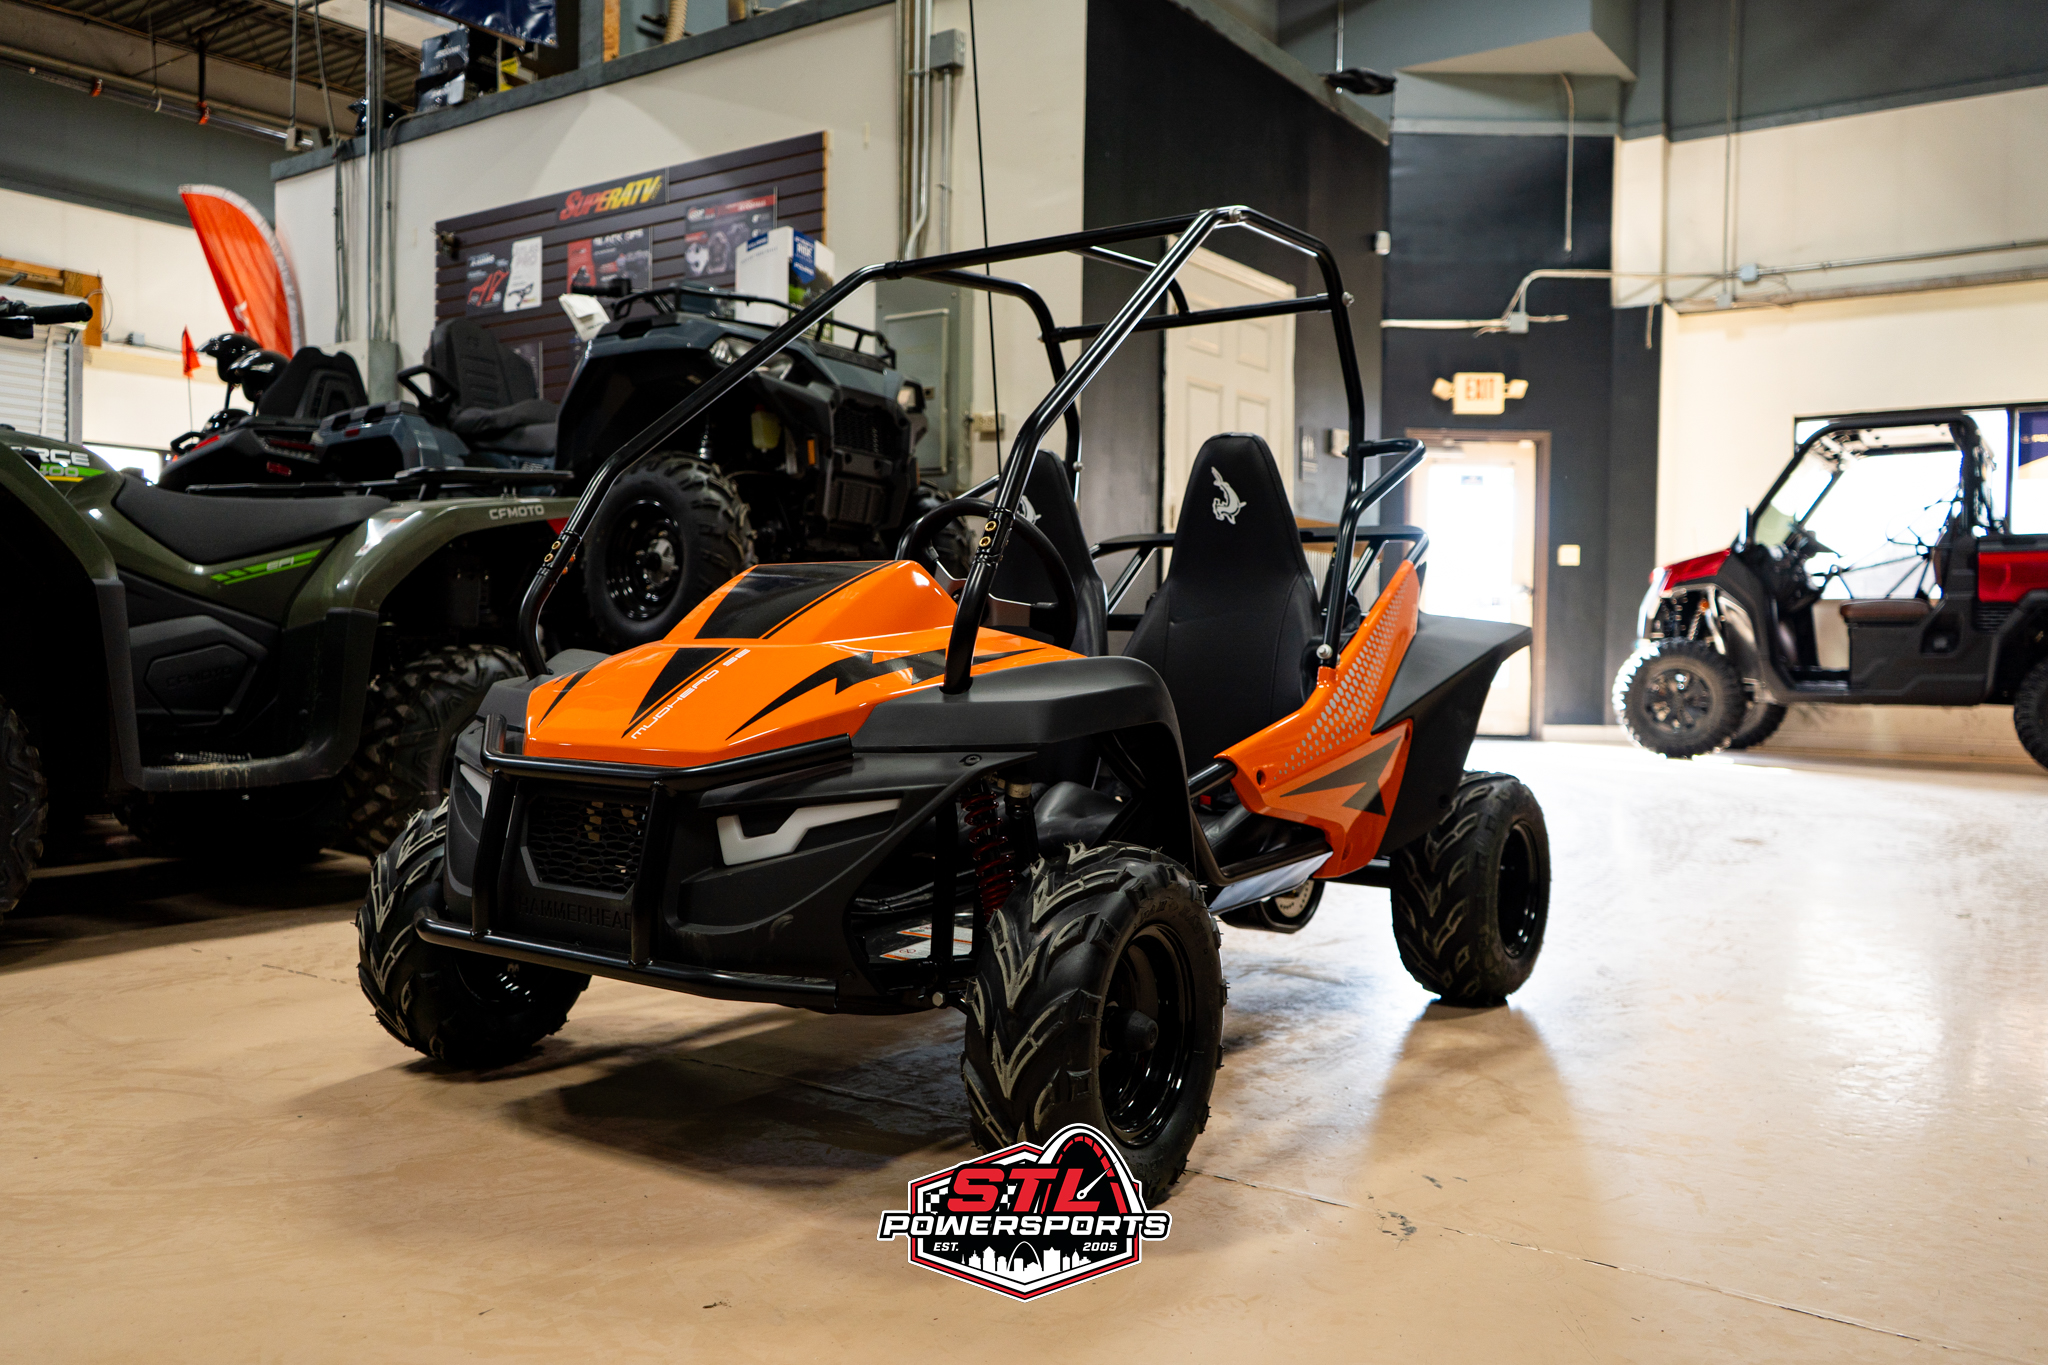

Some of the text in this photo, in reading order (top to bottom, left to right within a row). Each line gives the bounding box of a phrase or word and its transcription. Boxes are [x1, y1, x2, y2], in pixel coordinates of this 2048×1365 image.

[1466, 377, 1494, 400] EXIT
[489, 504, 545, 520] CFMOTO
[267, 556, 294, 571] EFI
